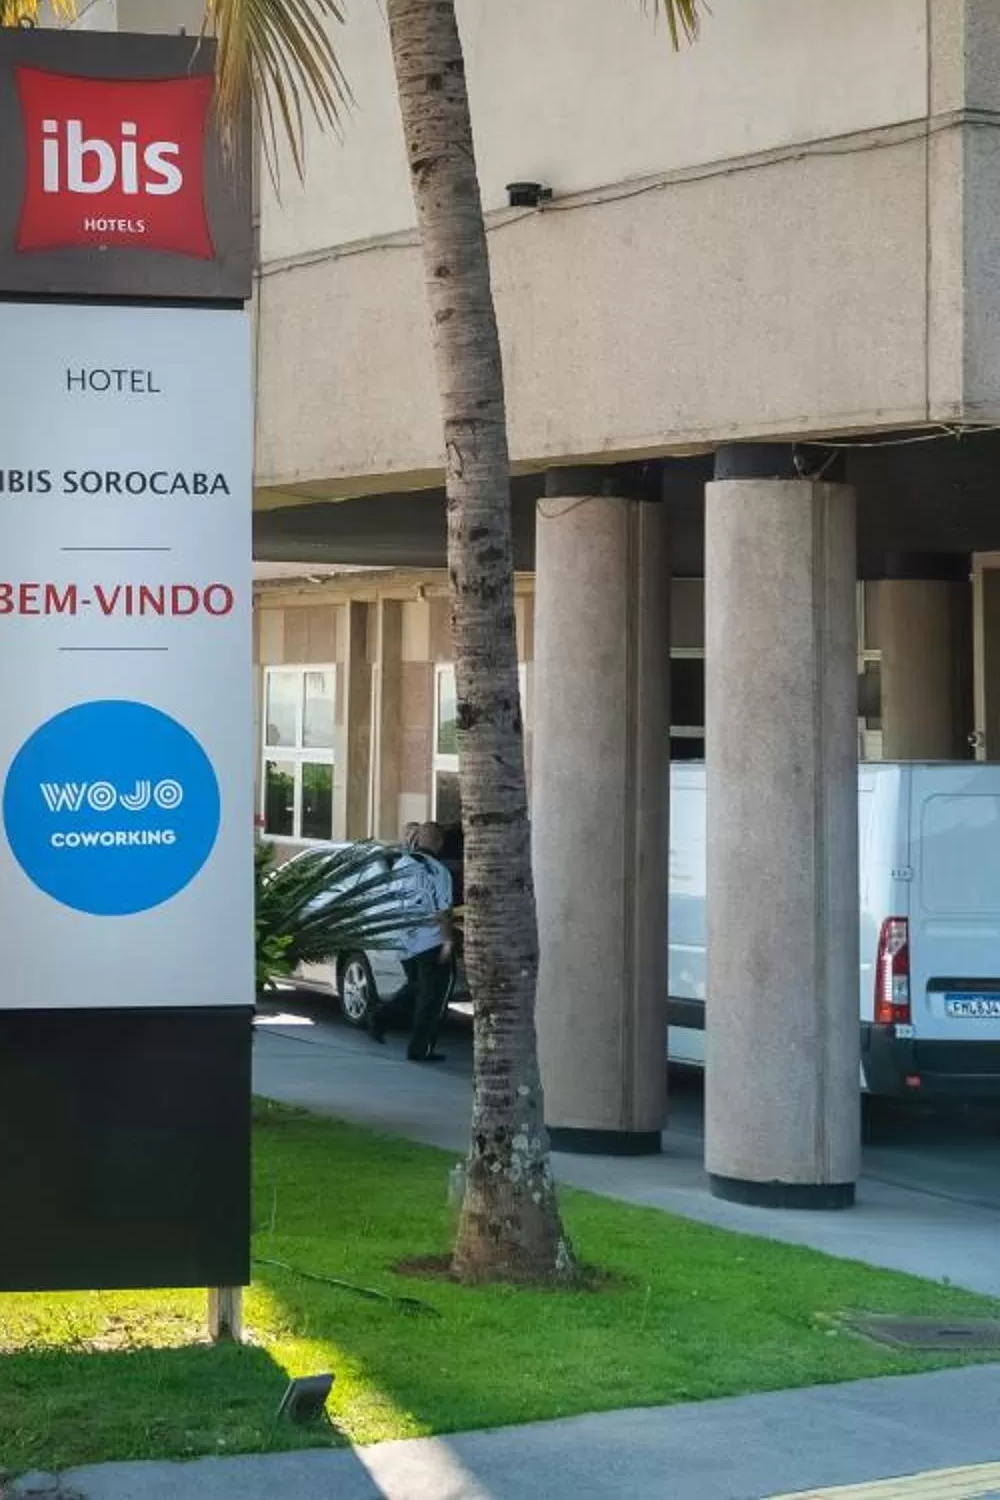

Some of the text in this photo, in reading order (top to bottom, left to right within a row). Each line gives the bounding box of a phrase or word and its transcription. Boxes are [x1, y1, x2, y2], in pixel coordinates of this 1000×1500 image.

[43, 120, 183, 195] ibis
[84, 218, 145, 233] HOTELS
[66, 368, 161, 393] HOTEL
[63, 471, 230, 495] SOROCABA
[40, 779, 183, 811] WOJO
[51, 830, 176, 848] COWORKING
